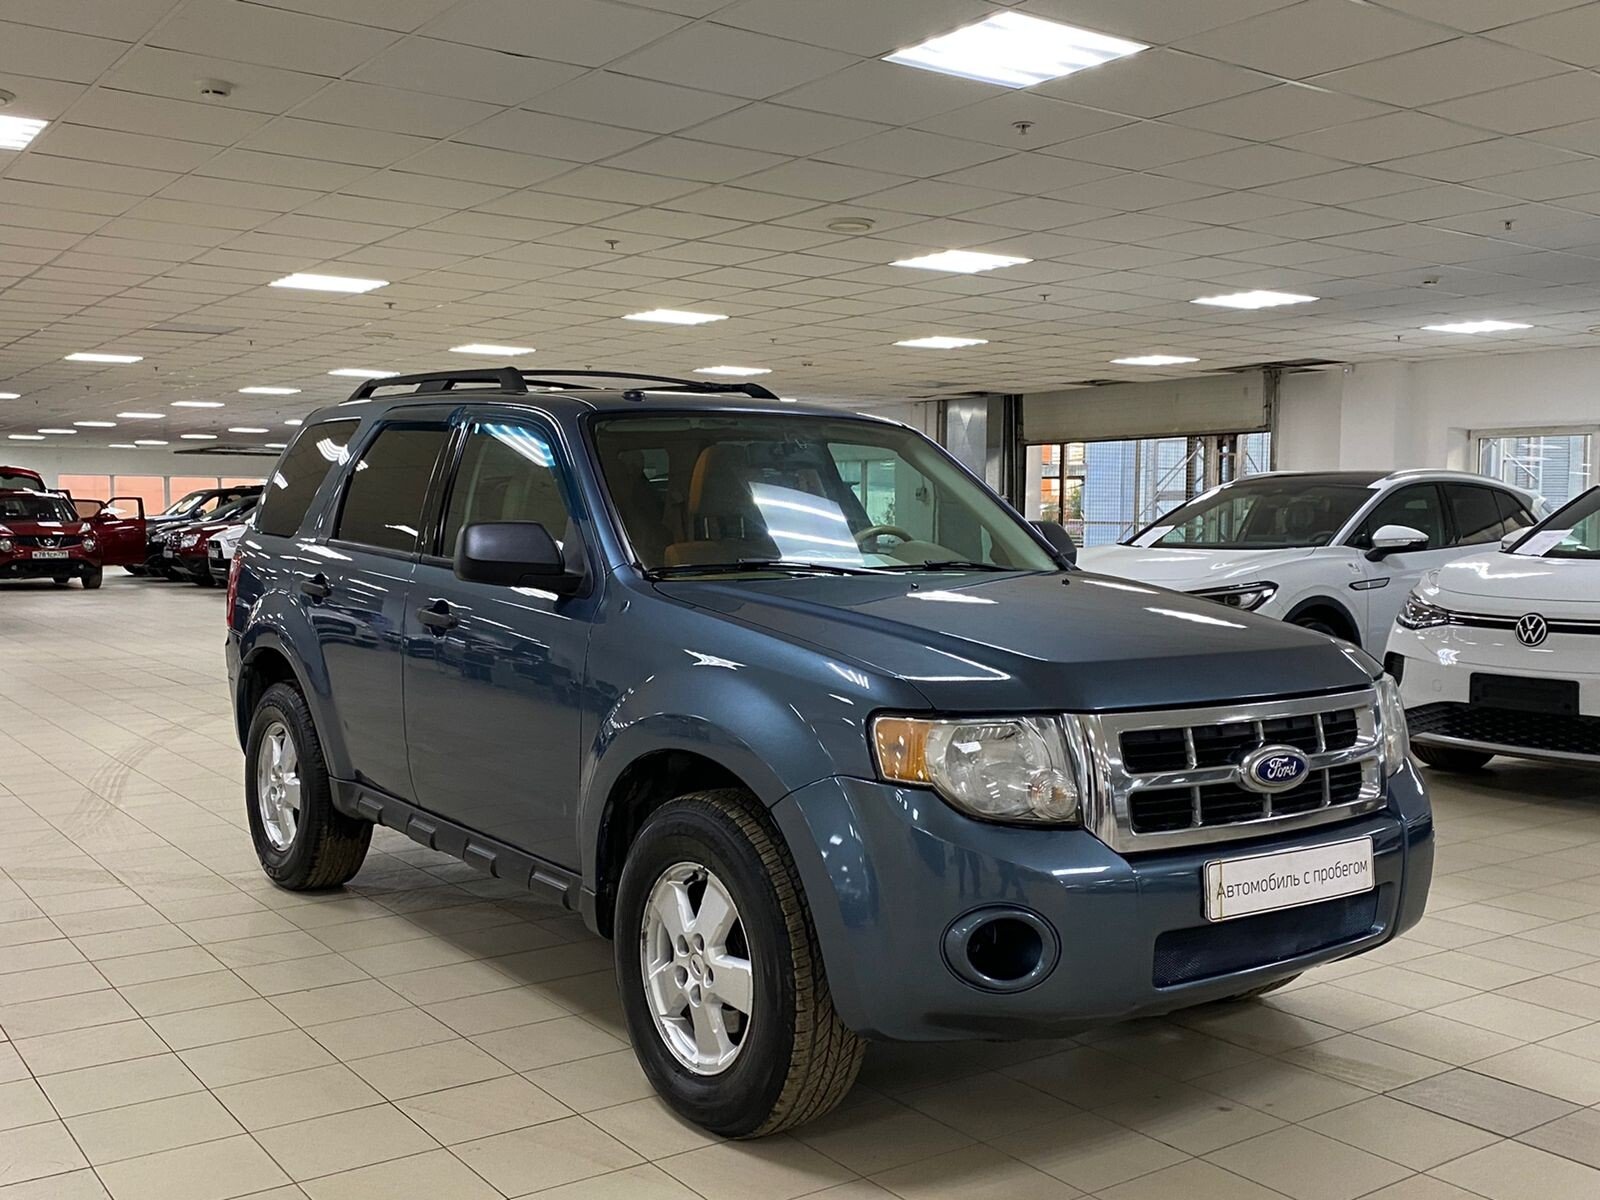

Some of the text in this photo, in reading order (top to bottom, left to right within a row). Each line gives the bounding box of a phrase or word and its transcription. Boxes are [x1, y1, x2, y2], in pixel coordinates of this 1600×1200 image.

[1266, 757, 1297, 779] Ford
[1216, 860, 1368, 900] Автомобиль с пробегом
